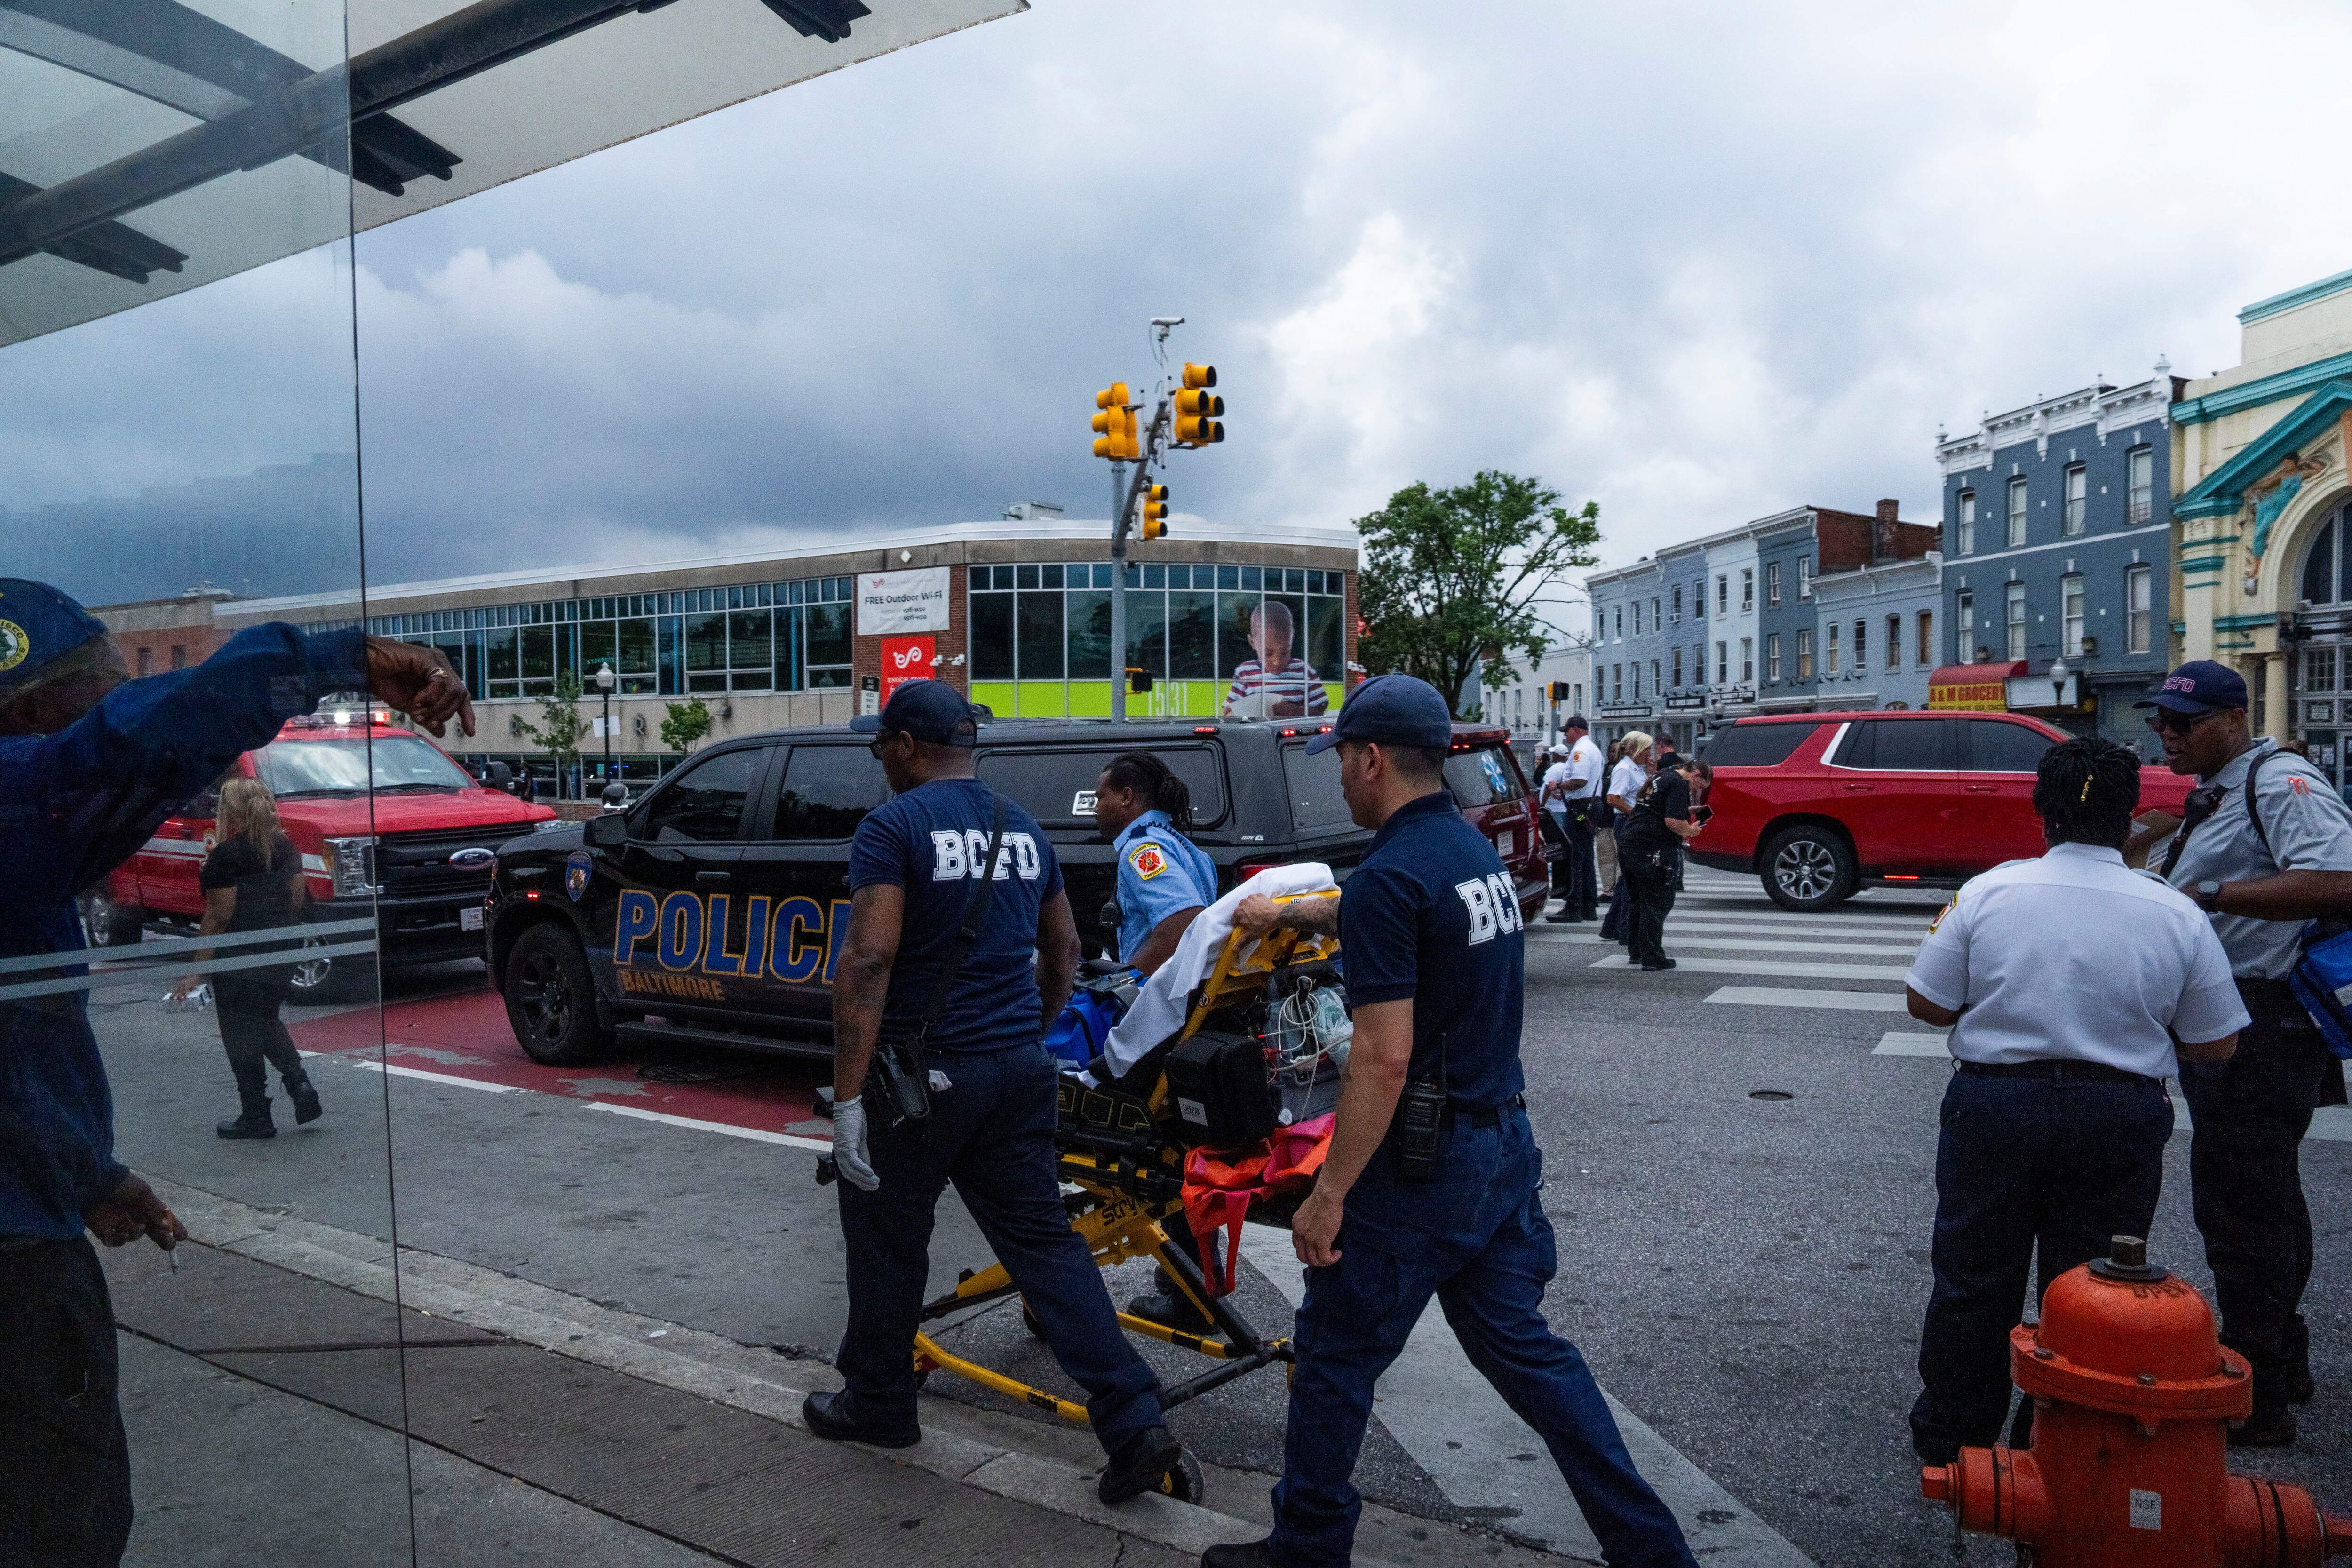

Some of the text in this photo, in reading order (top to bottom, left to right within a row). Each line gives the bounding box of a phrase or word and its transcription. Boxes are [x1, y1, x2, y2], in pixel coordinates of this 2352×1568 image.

[865, 590, 942, 605] FREE Outdoor Wi-Fi
[1148, 682, 1187, 716] 1531
[1947, 687, 1955, 701] M
[930, 830, 1040, 881] BCFD
[621, 970, 725, 1001] BALTIMORE
[1183, 1103, 1201, 1115] LIFEPAK
[2135, 1497, 2156, 1510] NSF
